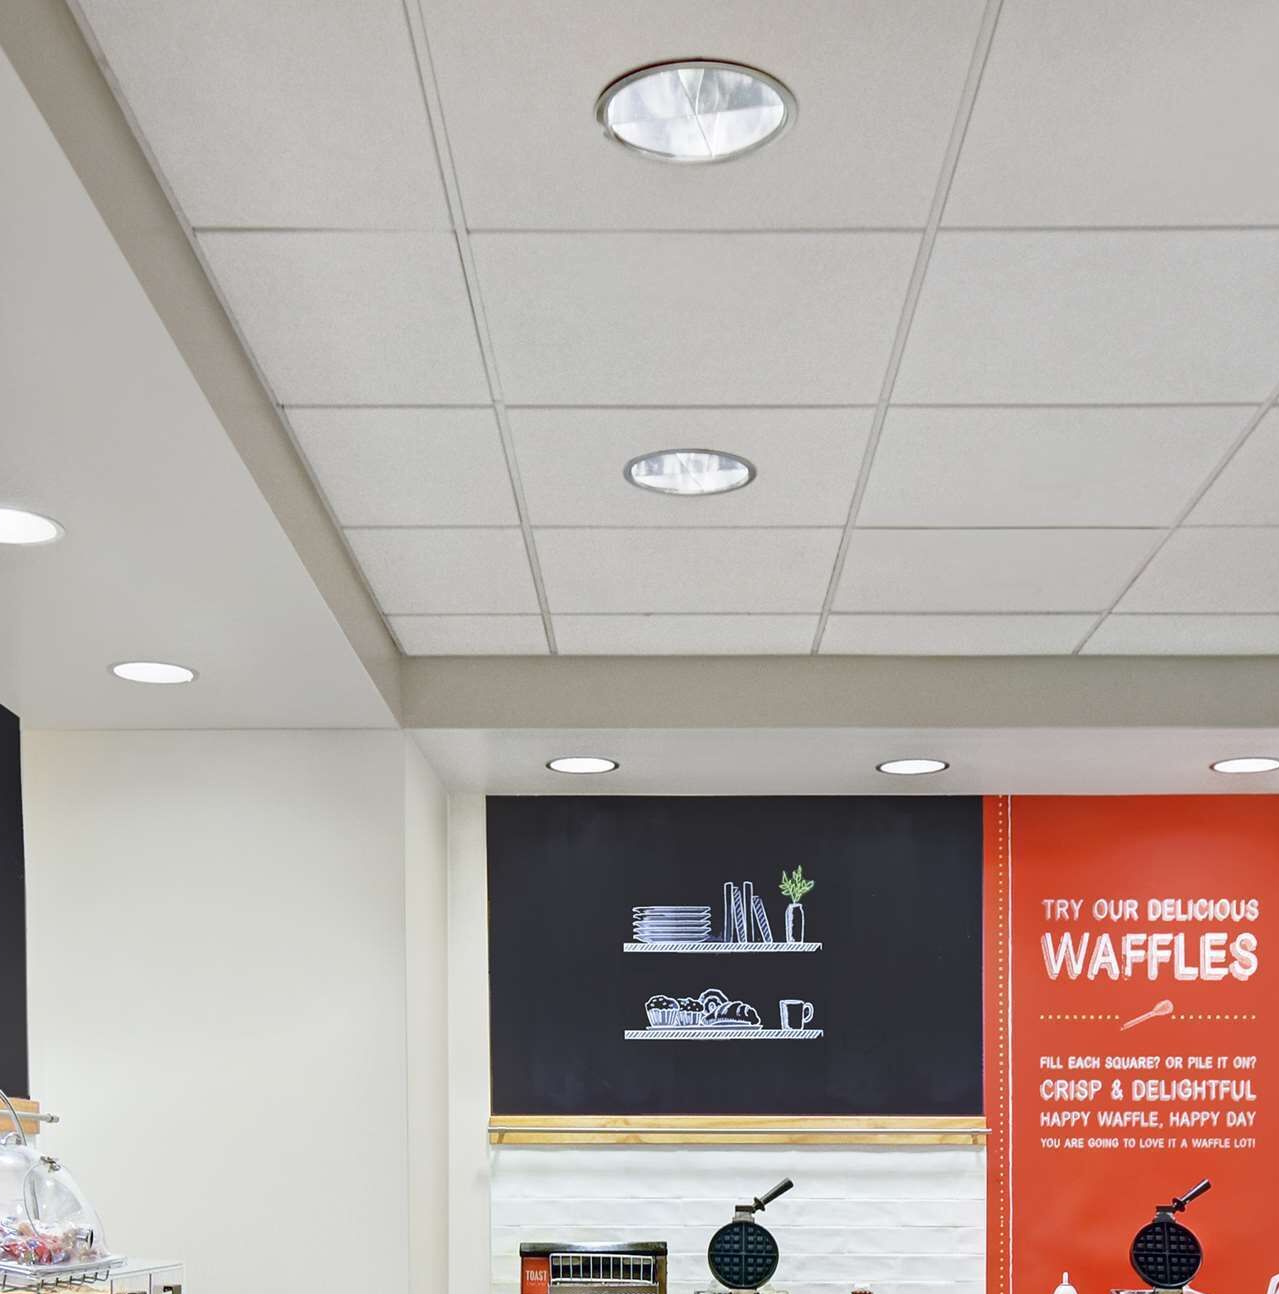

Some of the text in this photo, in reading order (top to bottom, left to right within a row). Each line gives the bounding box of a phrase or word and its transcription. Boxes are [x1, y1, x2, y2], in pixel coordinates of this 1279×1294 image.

[1042, 898, 1259, 922] TRY OUR DELICIOUS
[1040, 931, 1258, 981] WAFFLES
[1040, 1056, 1256, 1070] FILL EACH SQUARE? OR PILE IT ON?
[1040, 1078, 1257, 1102] CRISP & DELIGHTFUL
[1040, 1111, 1256, 1129] HAPPY WAFFLE, HAPPY DAY
[1041, 1138, 1255, 1148] YOU ARE GOING TO LOVE IT A WAFFLE LOT!
[525, 1270, 548, 1281] TOAST
